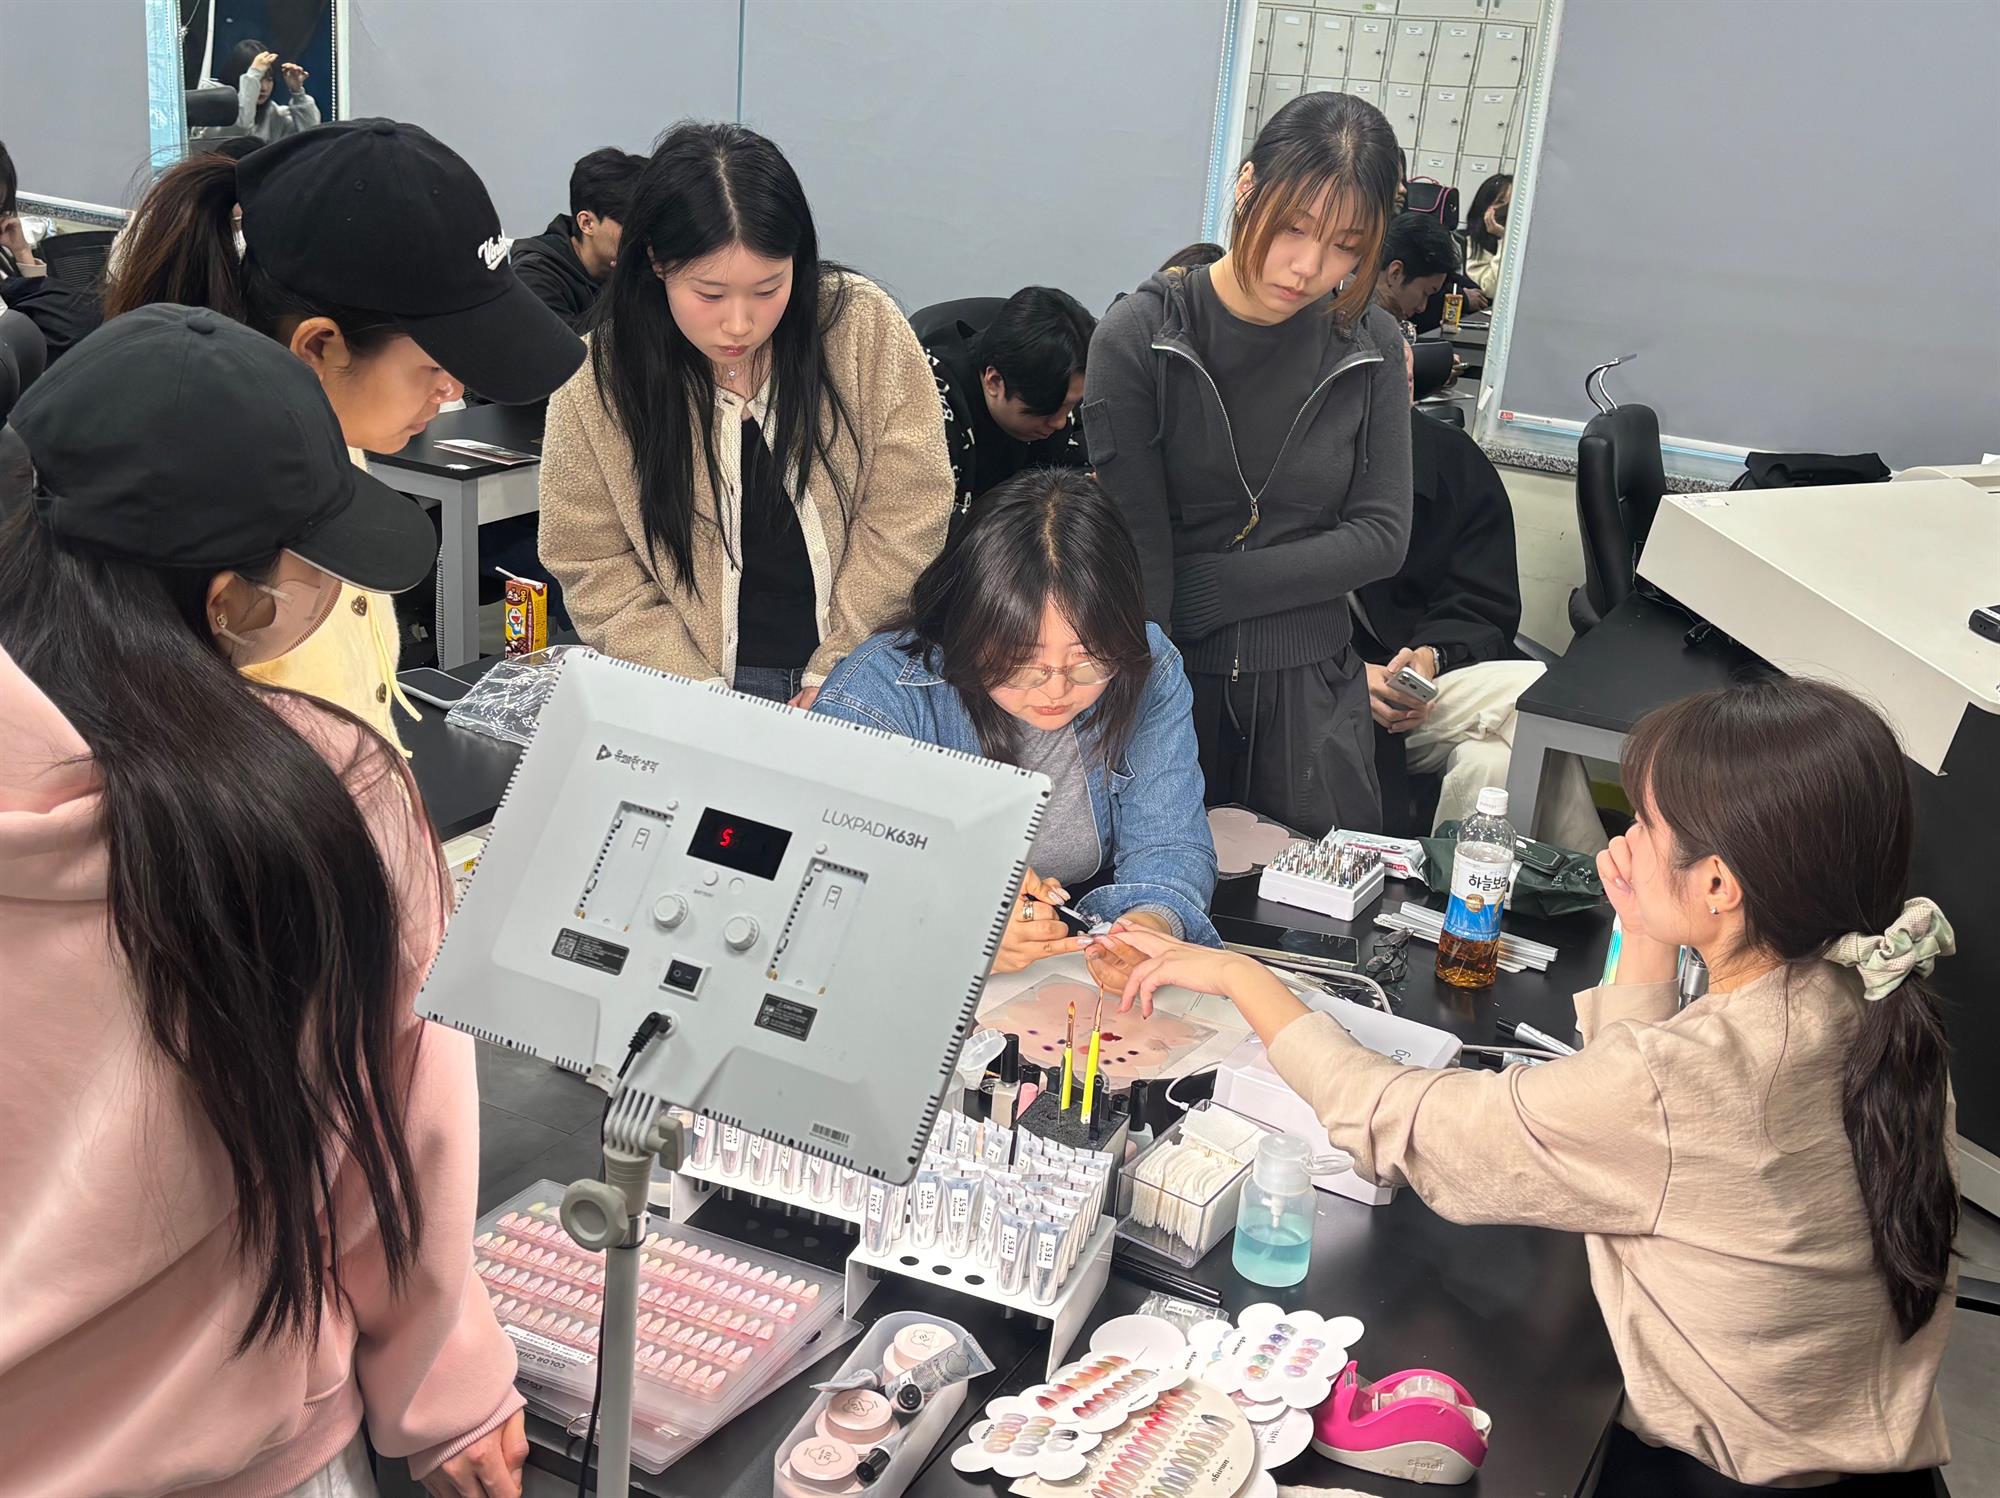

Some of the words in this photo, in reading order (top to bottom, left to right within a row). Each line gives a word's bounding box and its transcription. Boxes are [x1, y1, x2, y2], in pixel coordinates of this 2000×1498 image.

[870, 1193, 878, 1213] TEST
[926, 1190, 935, 1209] TEST
[958, 1197, 967, 1217] TEST
[1007, 1235, 1016, 1255] TEST
[1044, 1242, 1053, 1262] TEST
